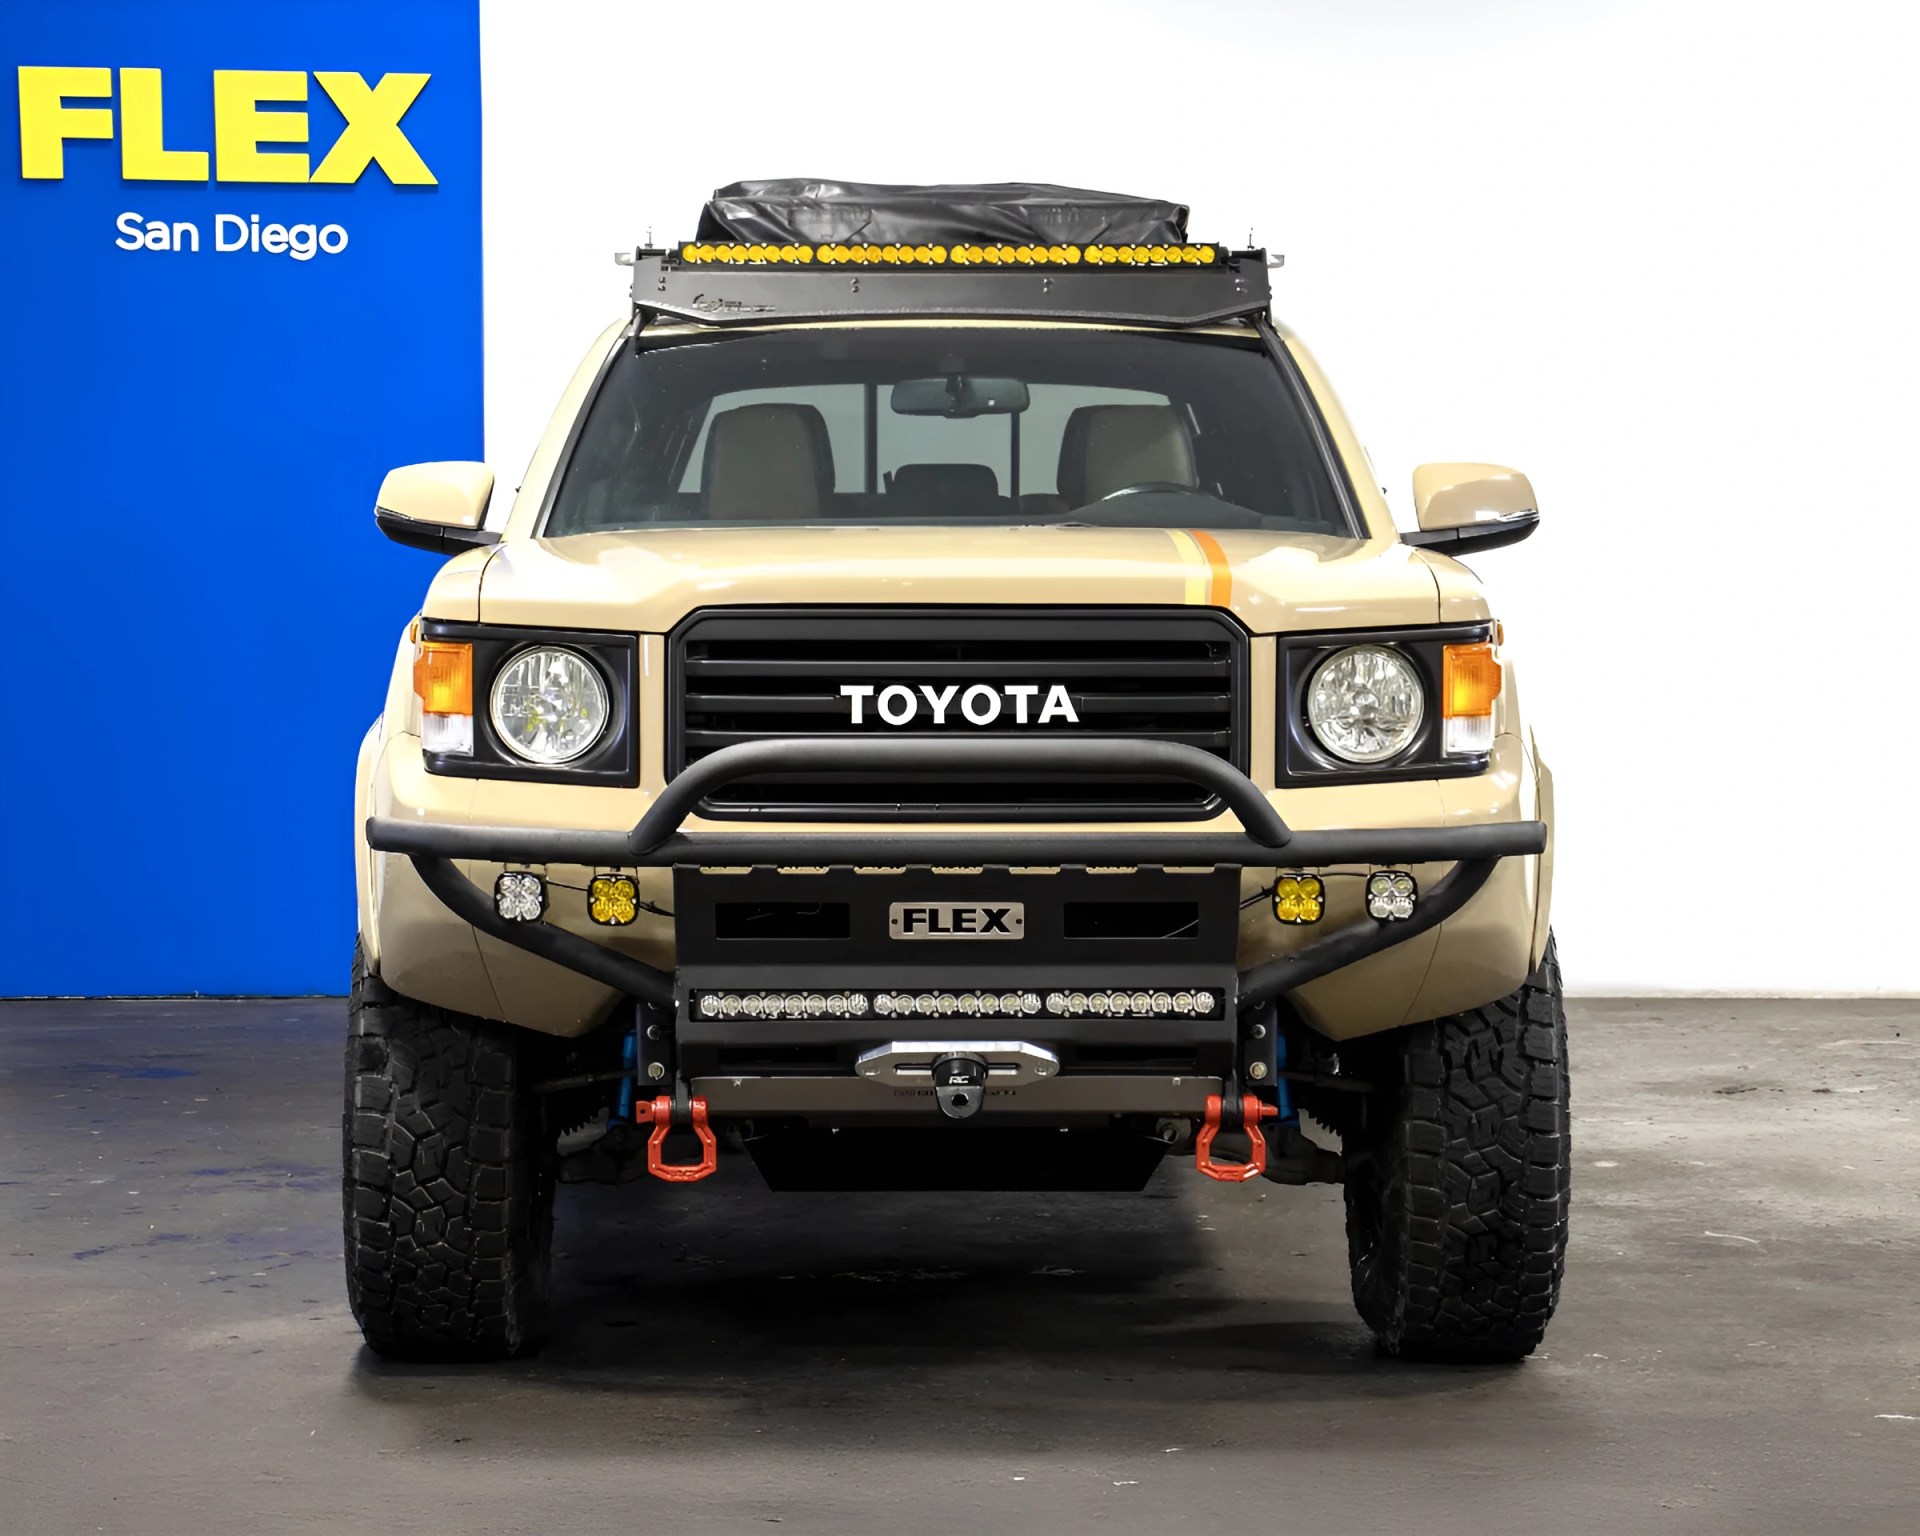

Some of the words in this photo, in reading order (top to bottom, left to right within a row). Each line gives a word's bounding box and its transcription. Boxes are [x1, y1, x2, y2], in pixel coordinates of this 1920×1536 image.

[17, 66, 439, 184] FLEX
[116, 212, 199, 251] San
[215, 213, 348, 260] Diego
[840, 685, 1080, 726] TOYOTA
[903, 908, 1011, 933] FLEX
